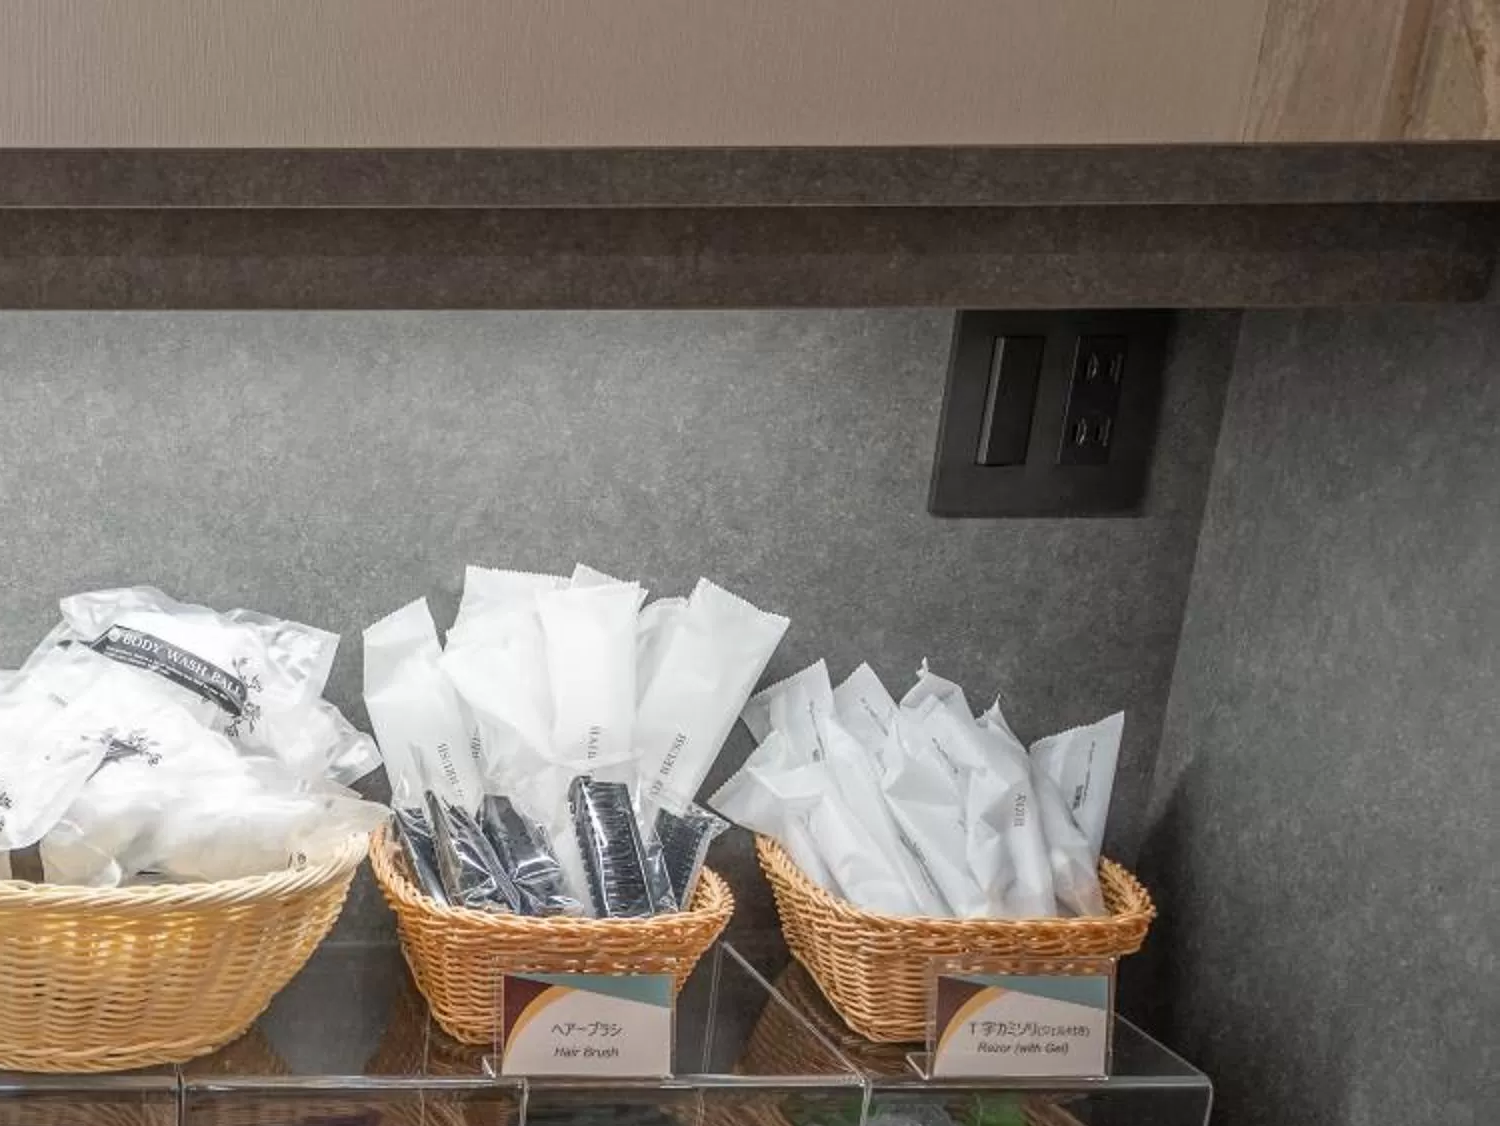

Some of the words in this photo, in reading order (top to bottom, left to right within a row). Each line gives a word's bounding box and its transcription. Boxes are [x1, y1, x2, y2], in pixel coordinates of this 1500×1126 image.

[121, 632, 163, 655] BODY
[167, 648, 209, 677] WASH
[551, 1020, 624, 1037] ヘアーブラシ
[553, 1047, 581, 1058] Hair
[583, 1046, 619, 1058] Brush
[977, 1042, 1011, 1053] Razor
[1014, 1042, 1042, 1055] (with
[1044, 1042, 1070, 1055] Gel)
